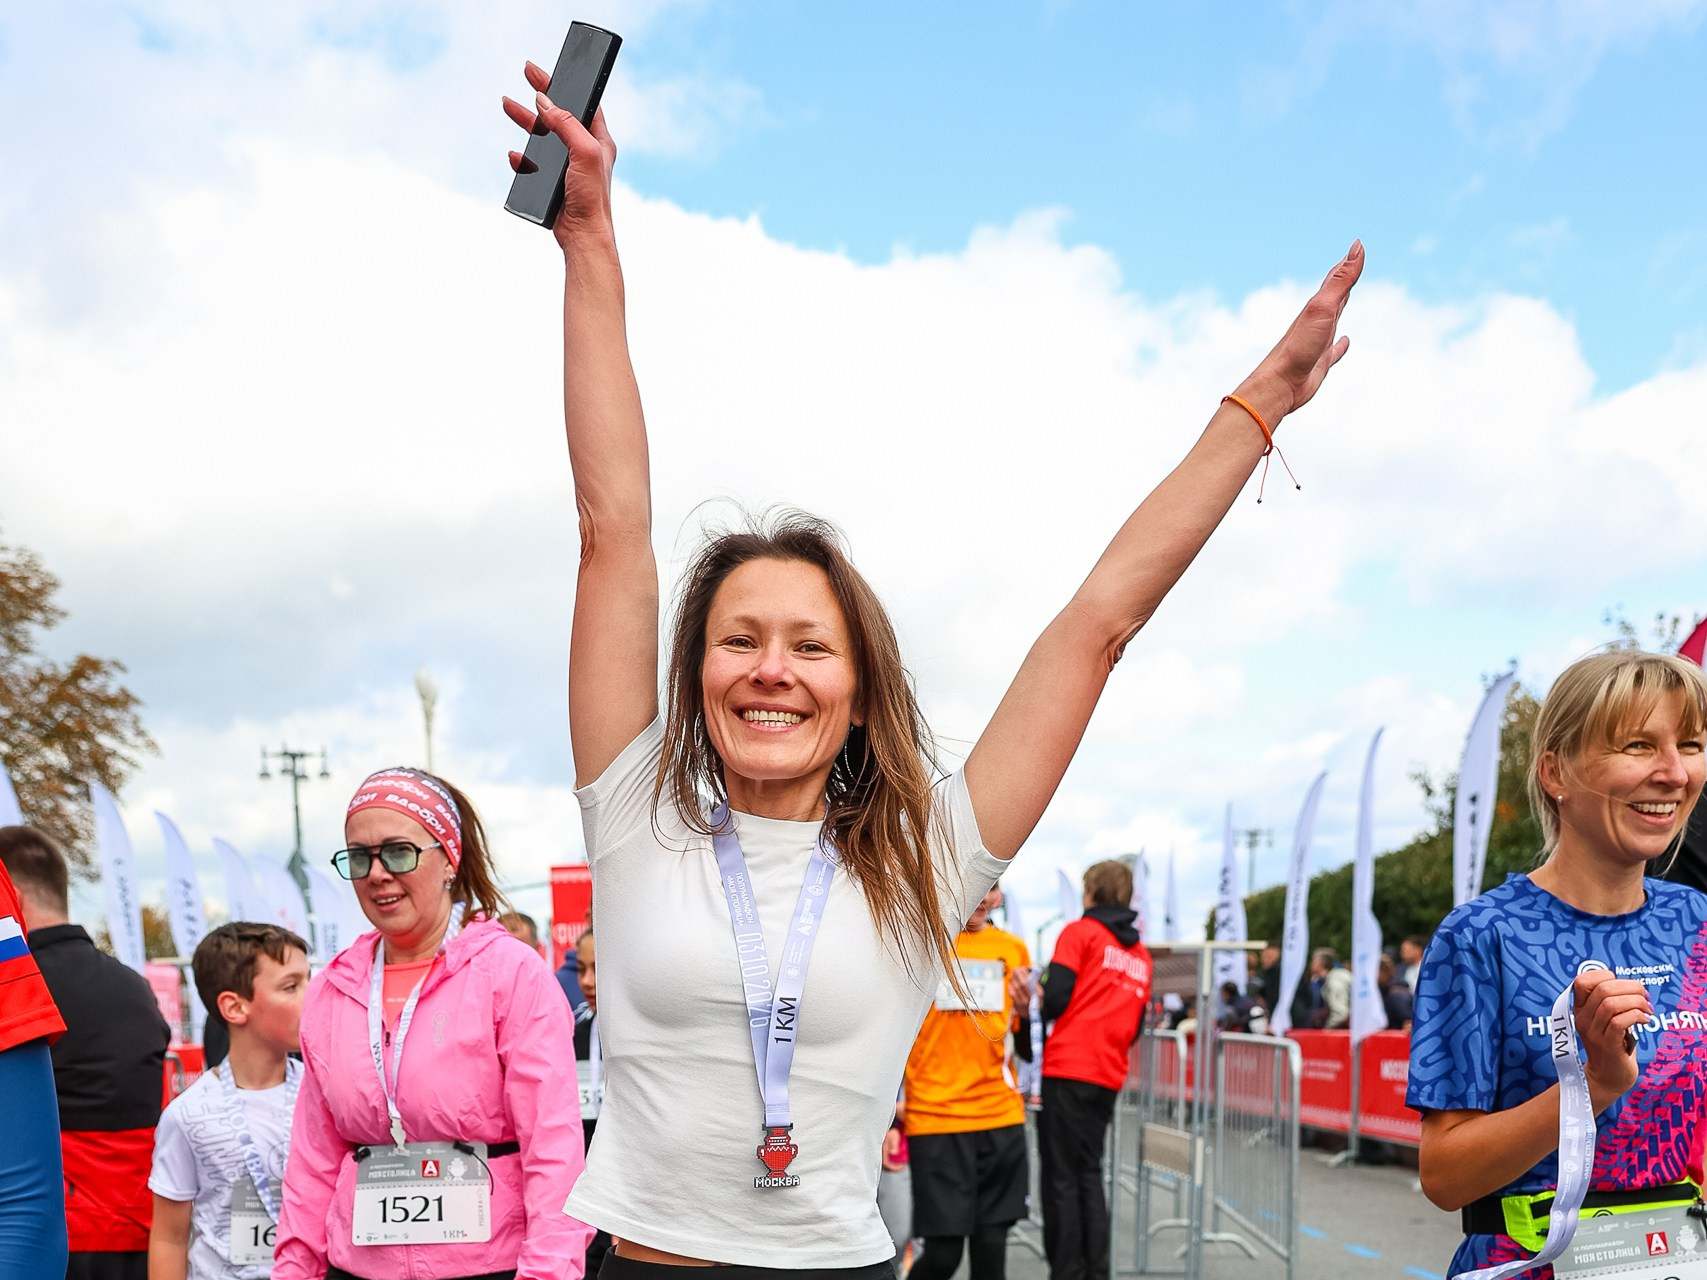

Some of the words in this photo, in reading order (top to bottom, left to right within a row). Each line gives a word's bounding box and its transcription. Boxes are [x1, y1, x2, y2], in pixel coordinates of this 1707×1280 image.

[225, 1095, 269, 1188] МОСКВА
[755, 1175, 800, 1188] МОСКВА
[378, 1195, 443, 1223] 1521
